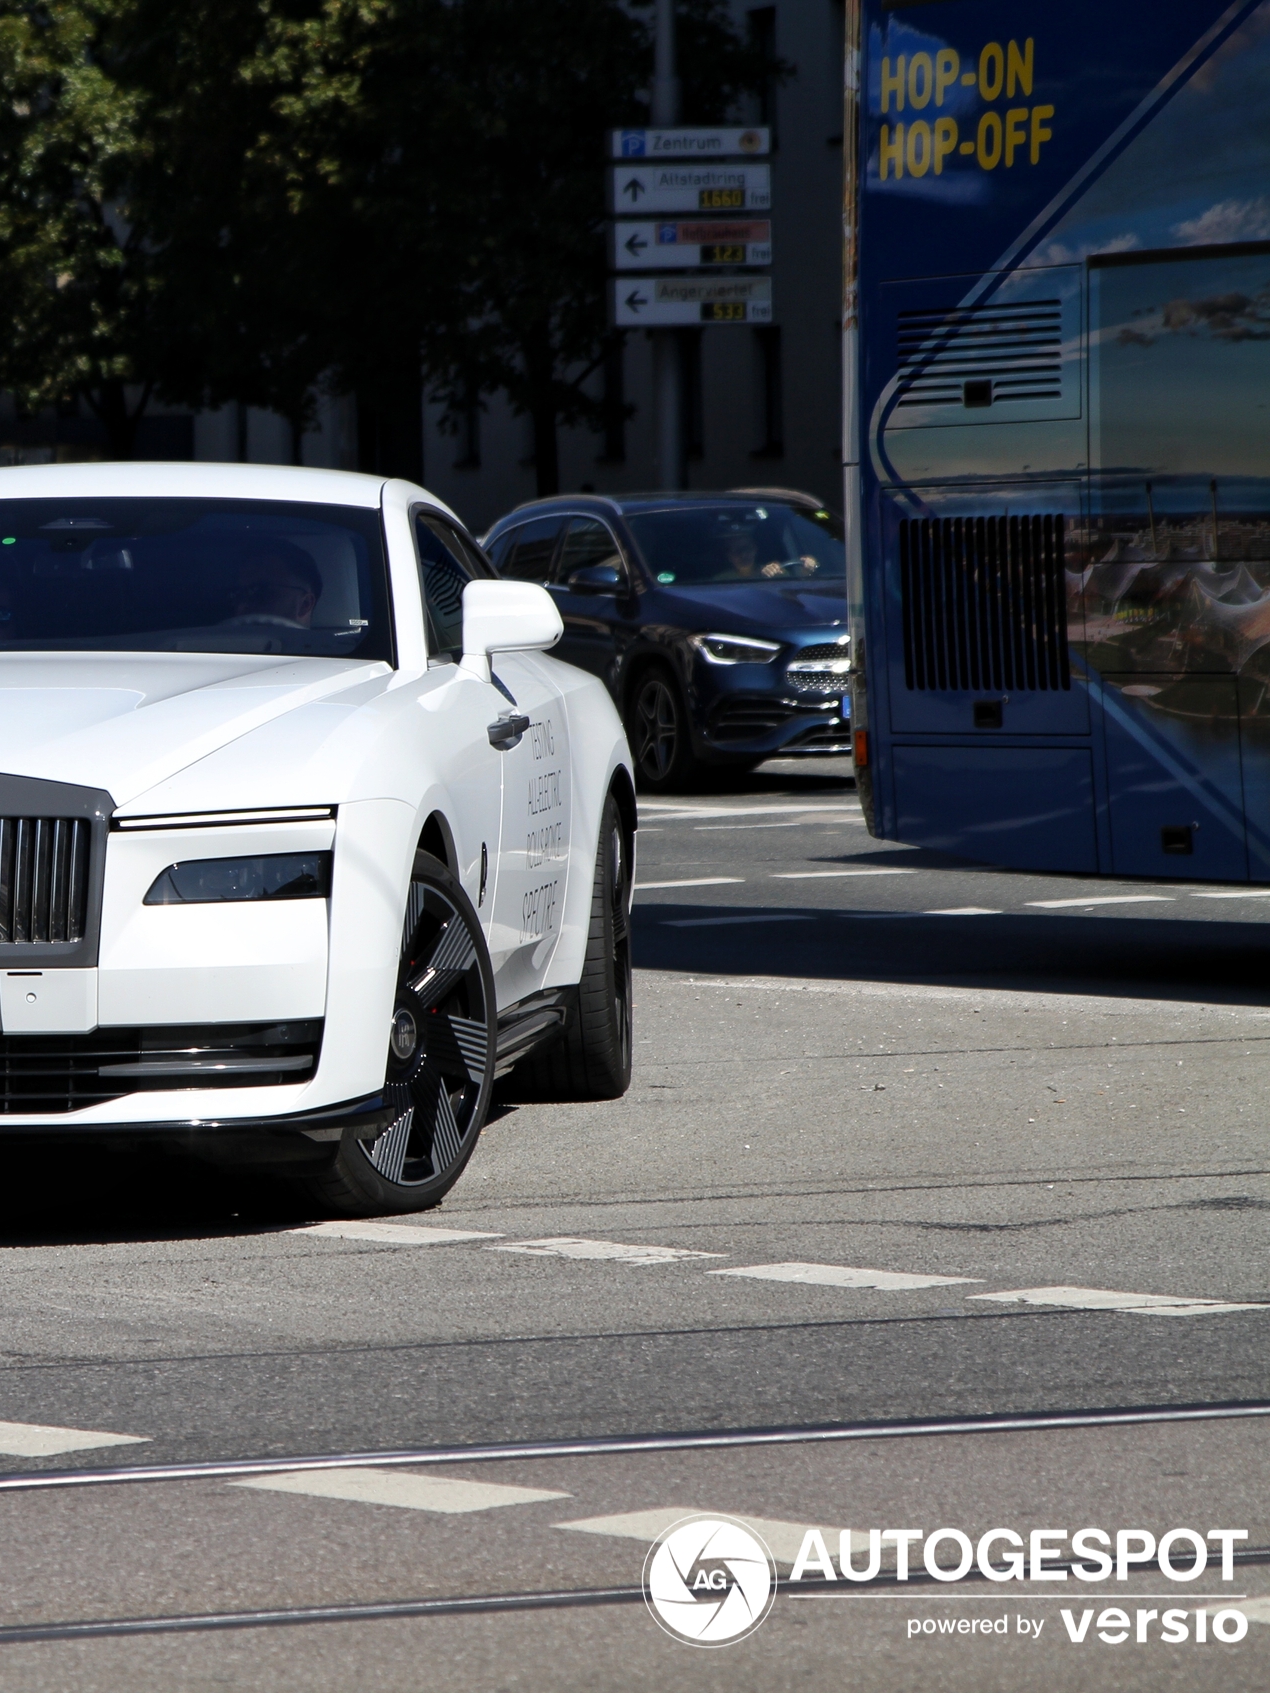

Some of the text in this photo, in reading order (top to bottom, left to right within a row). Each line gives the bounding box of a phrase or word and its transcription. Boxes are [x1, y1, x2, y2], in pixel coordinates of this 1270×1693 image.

[881, 37, 1034, 114] HOP-ON
[653, 135, 720, 151] Zentrum
[880, 104, 1055, 181] HOP-OFF
[659, 172, 745, 188] Altstadtring
[701, 190, 769, 207] 1660 frei
[751, 247, 770, 259] frei
[659, 283, 752, 300] Angerviertel
[752, 305, 770, 317] frei
[529, 719, 555, 760] TESTING
[519, 880, 558, 944] SPECTRE
